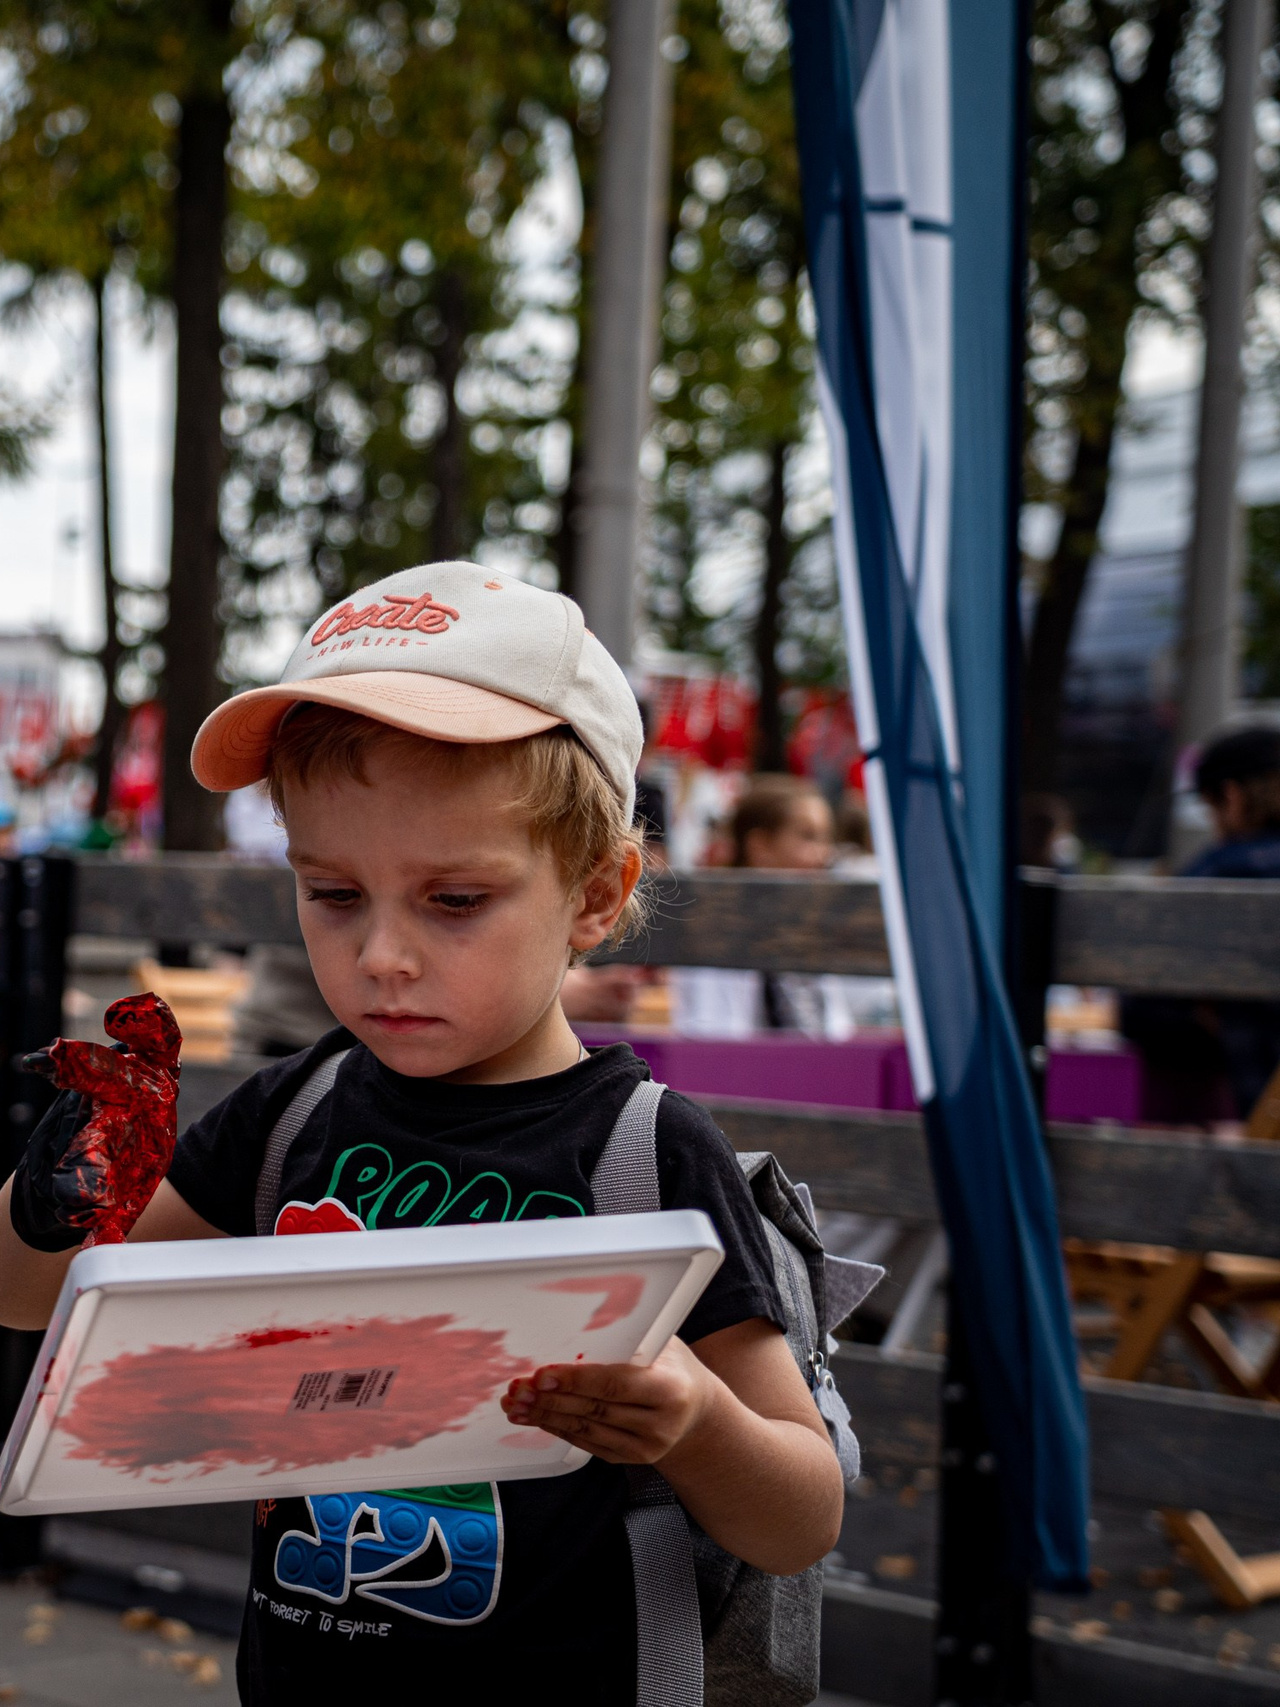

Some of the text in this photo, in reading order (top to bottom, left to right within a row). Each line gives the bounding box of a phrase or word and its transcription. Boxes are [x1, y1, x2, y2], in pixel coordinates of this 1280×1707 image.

[311, 592, 460, 646] Create
[317, 636, 410, 658] NEW LIFE
[270, 1601, 312, 1625] FORGET
[319, 1611, 334, 1632] TO
[337, 1620, 392, 1641] SMILE
